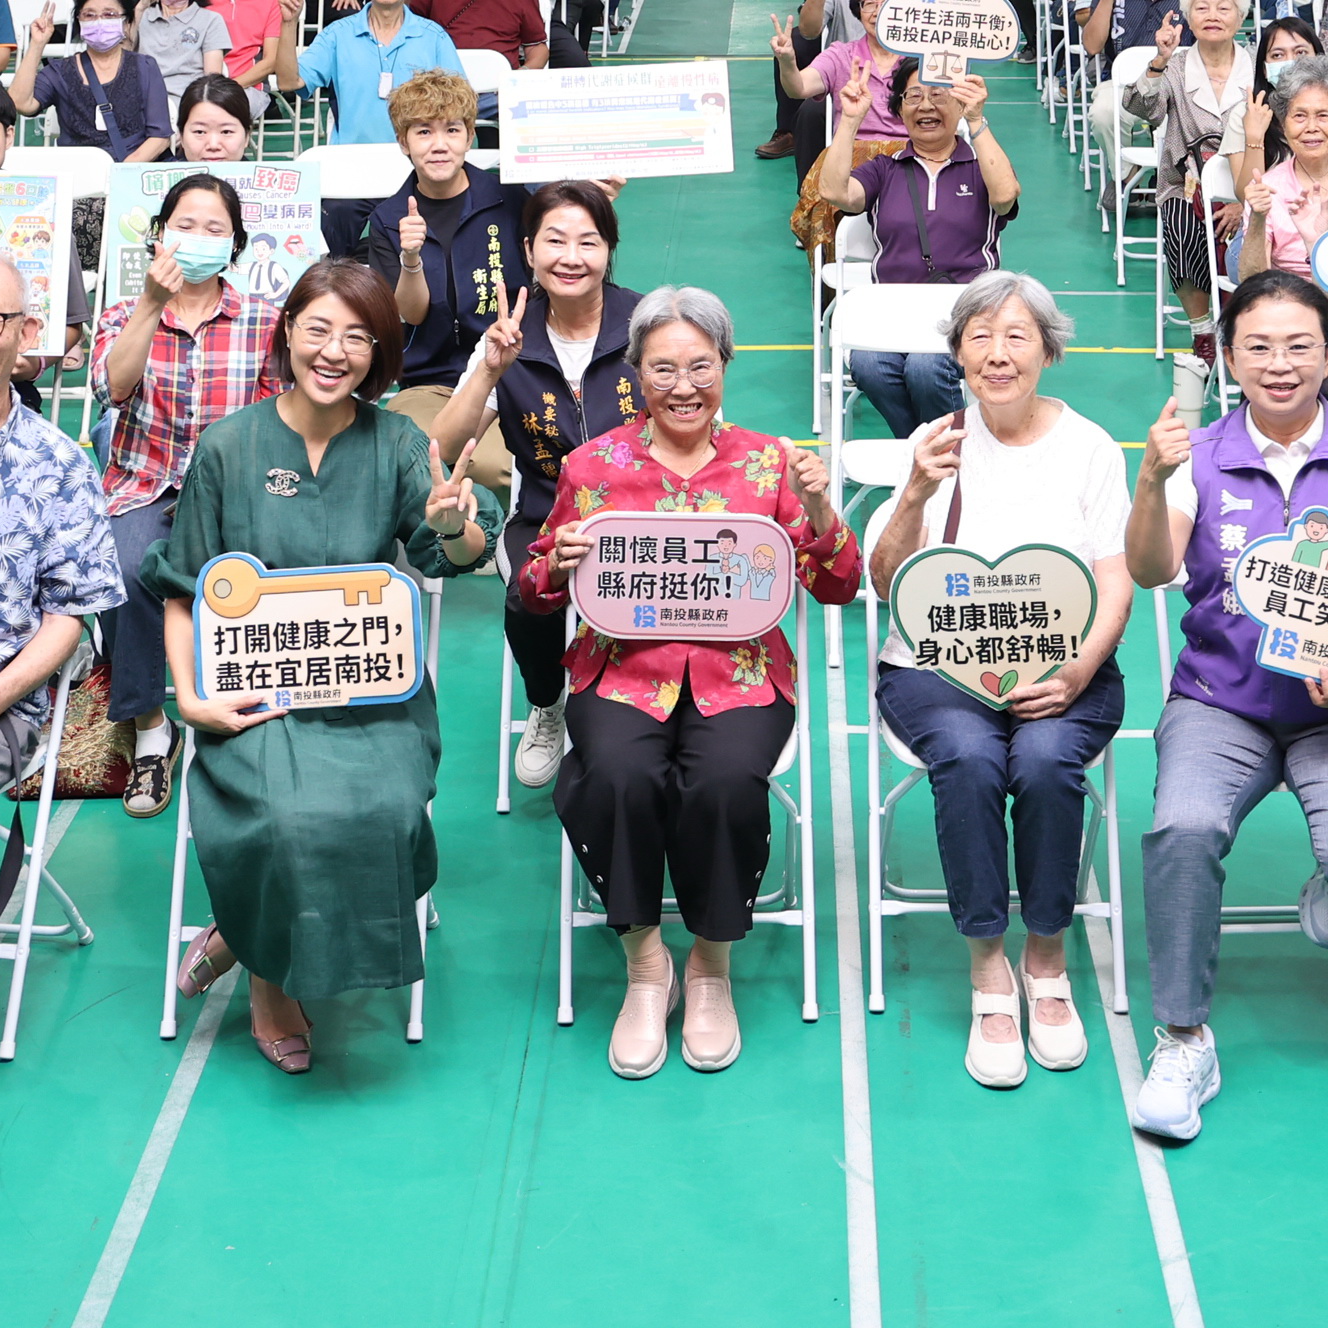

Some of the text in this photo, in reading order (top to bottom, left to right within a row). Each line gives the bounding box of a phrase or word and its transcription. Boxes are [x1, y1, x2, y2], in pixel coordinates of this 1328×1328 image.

[887, 7, 1013, 32] 工作生活兩平衡，
[885, 25, 1010, 51] 南投EAP最貼心！
[472, 269, 489, 315] 衛生局
[598, 535, 722, 565] 關懷員工
[597, 571, 732, 601] 縣府挺你！
[973, 573, 1041, 588] 南投縣政府
[660, 608, 729, 622] 南投縣政府
[927, 601, 1062, 633] 健康職場，
[213, 616, 403, 656] 打開健康之門，
[915, 634, 1079, 667] 身心都舒暢！
[215, 652, 405, 692] 盡在宜居南投！
[293, 689, 342, 700] 南投縣政府
